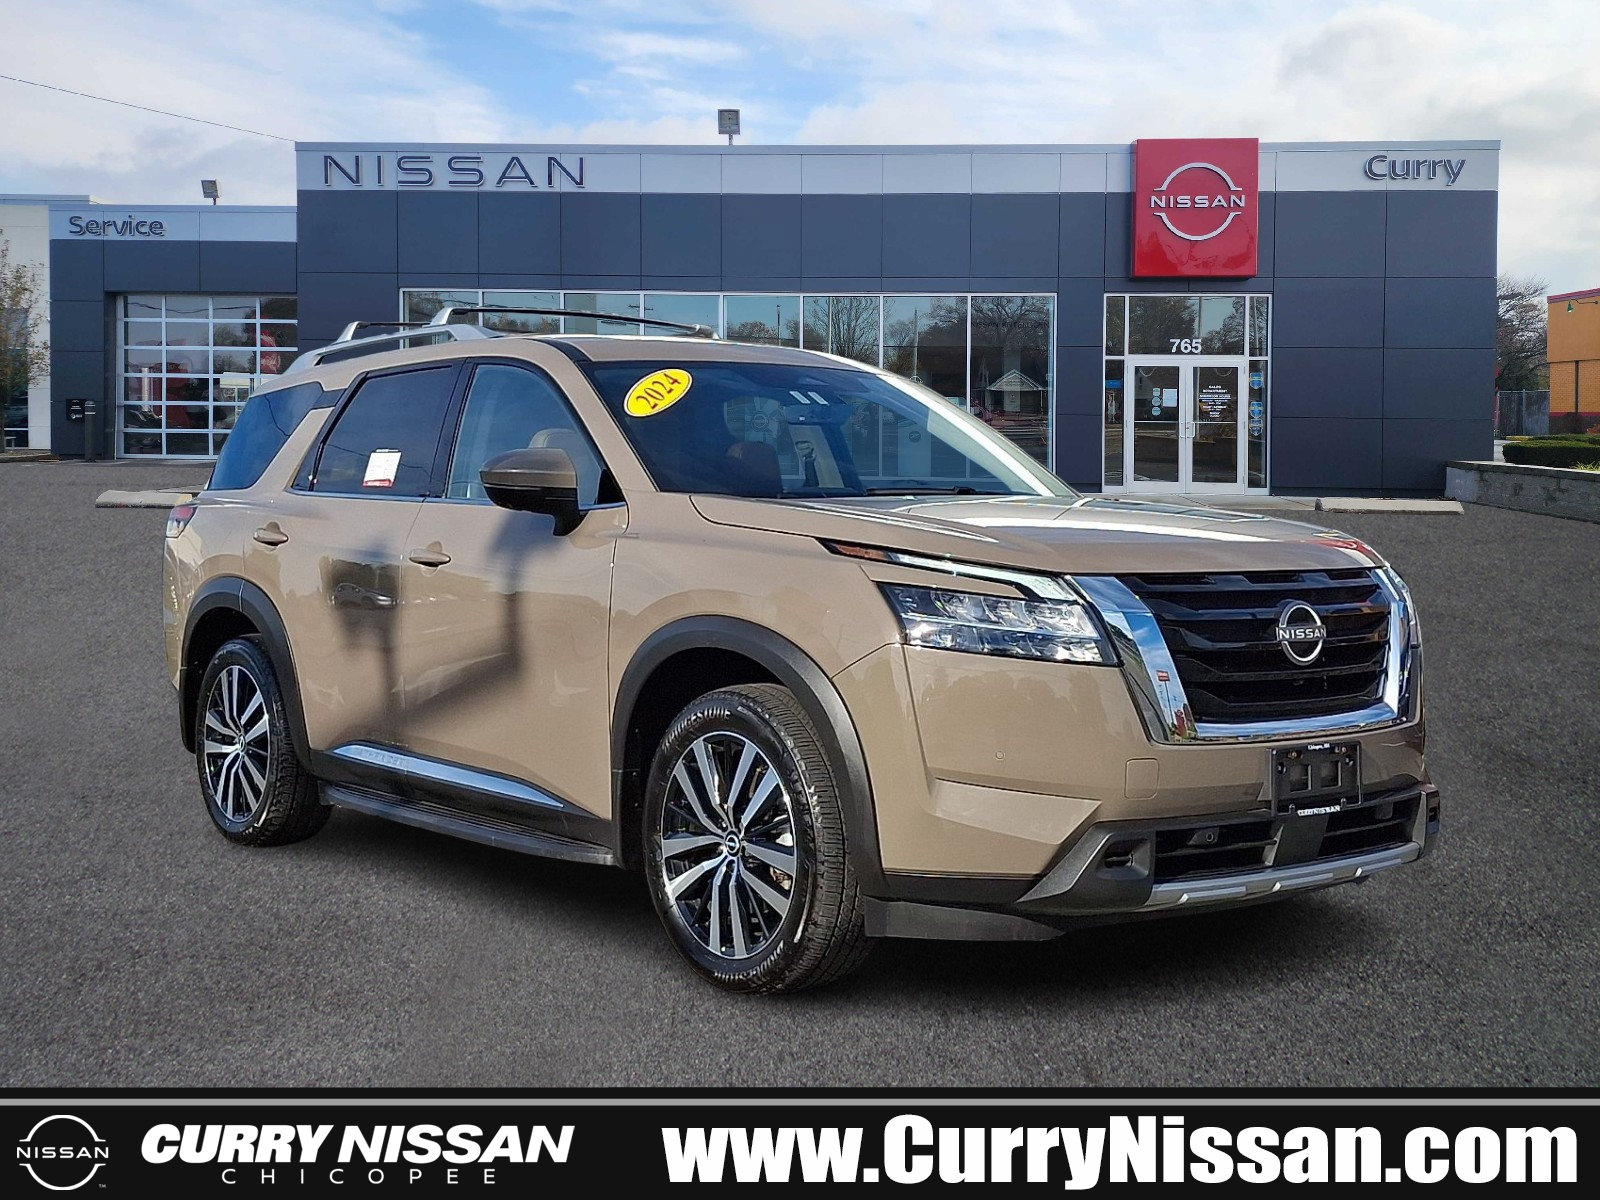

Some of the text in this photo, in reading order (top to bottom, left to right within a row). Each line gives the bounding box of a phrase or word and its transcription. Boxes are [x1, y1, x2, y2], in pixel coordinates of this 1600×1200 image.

[323, 155, 586, 188] NISSAN
[1364, 155, 1466, 187] Curry
[1150, 194, 1246, 209] NISSAN
[68, 214, 166, 237] Service
[1169, 338, 1202, 354] 765
[635, 372, 682, 410] 2024
[1279, 628, 1327, 639] NISSAN
